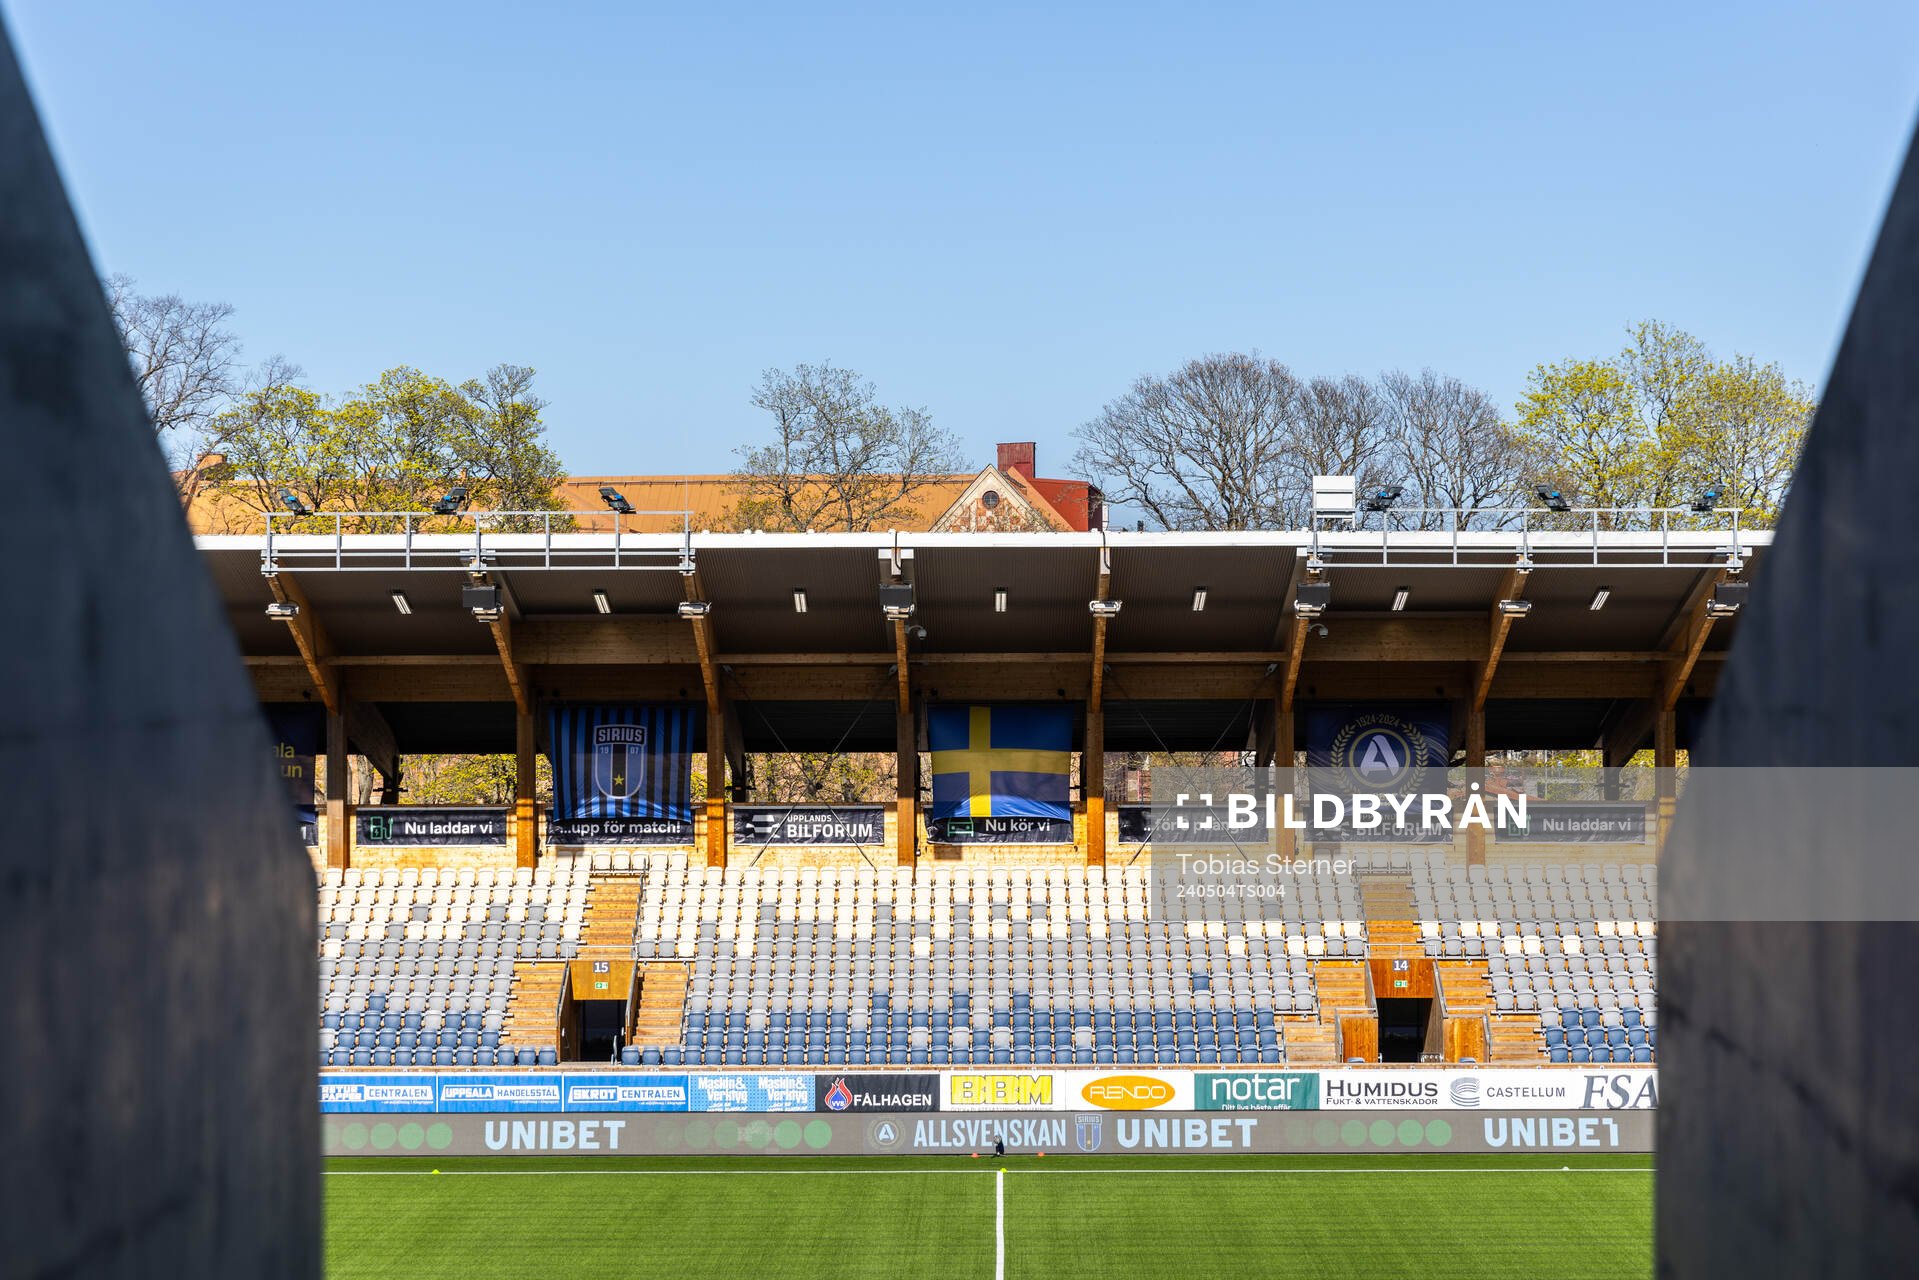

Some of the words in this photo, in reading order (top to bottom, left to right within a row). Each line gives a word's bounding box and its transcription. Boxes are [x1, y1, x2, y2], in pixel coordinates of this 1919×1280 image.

[598, 727, 643, 742] SIRIUS
[787, 814, 832, 822] UPPLANDS
[985, 818, 1006, 832] Nu
[1010, 818, 1035, 832] kör
[1037, 818, 1050, 832] vi
[1542, 818, 1564, 831] Nu
[1567, 818, 1615, 831] laddar
[1618, 817, 1632, 831] vi
[404, 821, 426, 835] Nu
[429, 821, 477, 835] laddar
[479, 821, 493, 835] vi
[604, 820, 626, 834] för
[629, 820, 681, 834] match!
[787, 823, 873, 838] BILFORUM
[594, 961, 609, 973] 15
[1393, 960, 1409, 971] 14
[369, 1089, 428, 1097] CENTRALEN
[445, 1087, 494, 1098] UPPSALA
[497, 1086, 557, 1097] HANDELSSTÅL
[621, 1089, 680, 1098] CENTRALEN
[951, 1075, 1053, 1105] BBM
[1090, 1085, 1167, 1099] RENDO
[1212, 1073, 1301, 1101] notar
[1326, 1079, 1439, 1097] HUMIDUS
[1486, 1086, 1565, 1098] CASTELLUM
[854, 1092, 932, 1106] FÅLHAGEN
[1326, 1097, 1354, 1105] FUKT-
[1355, 1097, 1362, 1105] &
[485, 1120, 626, 1150] UNIBET
[913, 1119, 1067, 1147] ALLSVENSKAN
[1117, 1118, 1258, 1149] UNIBET
